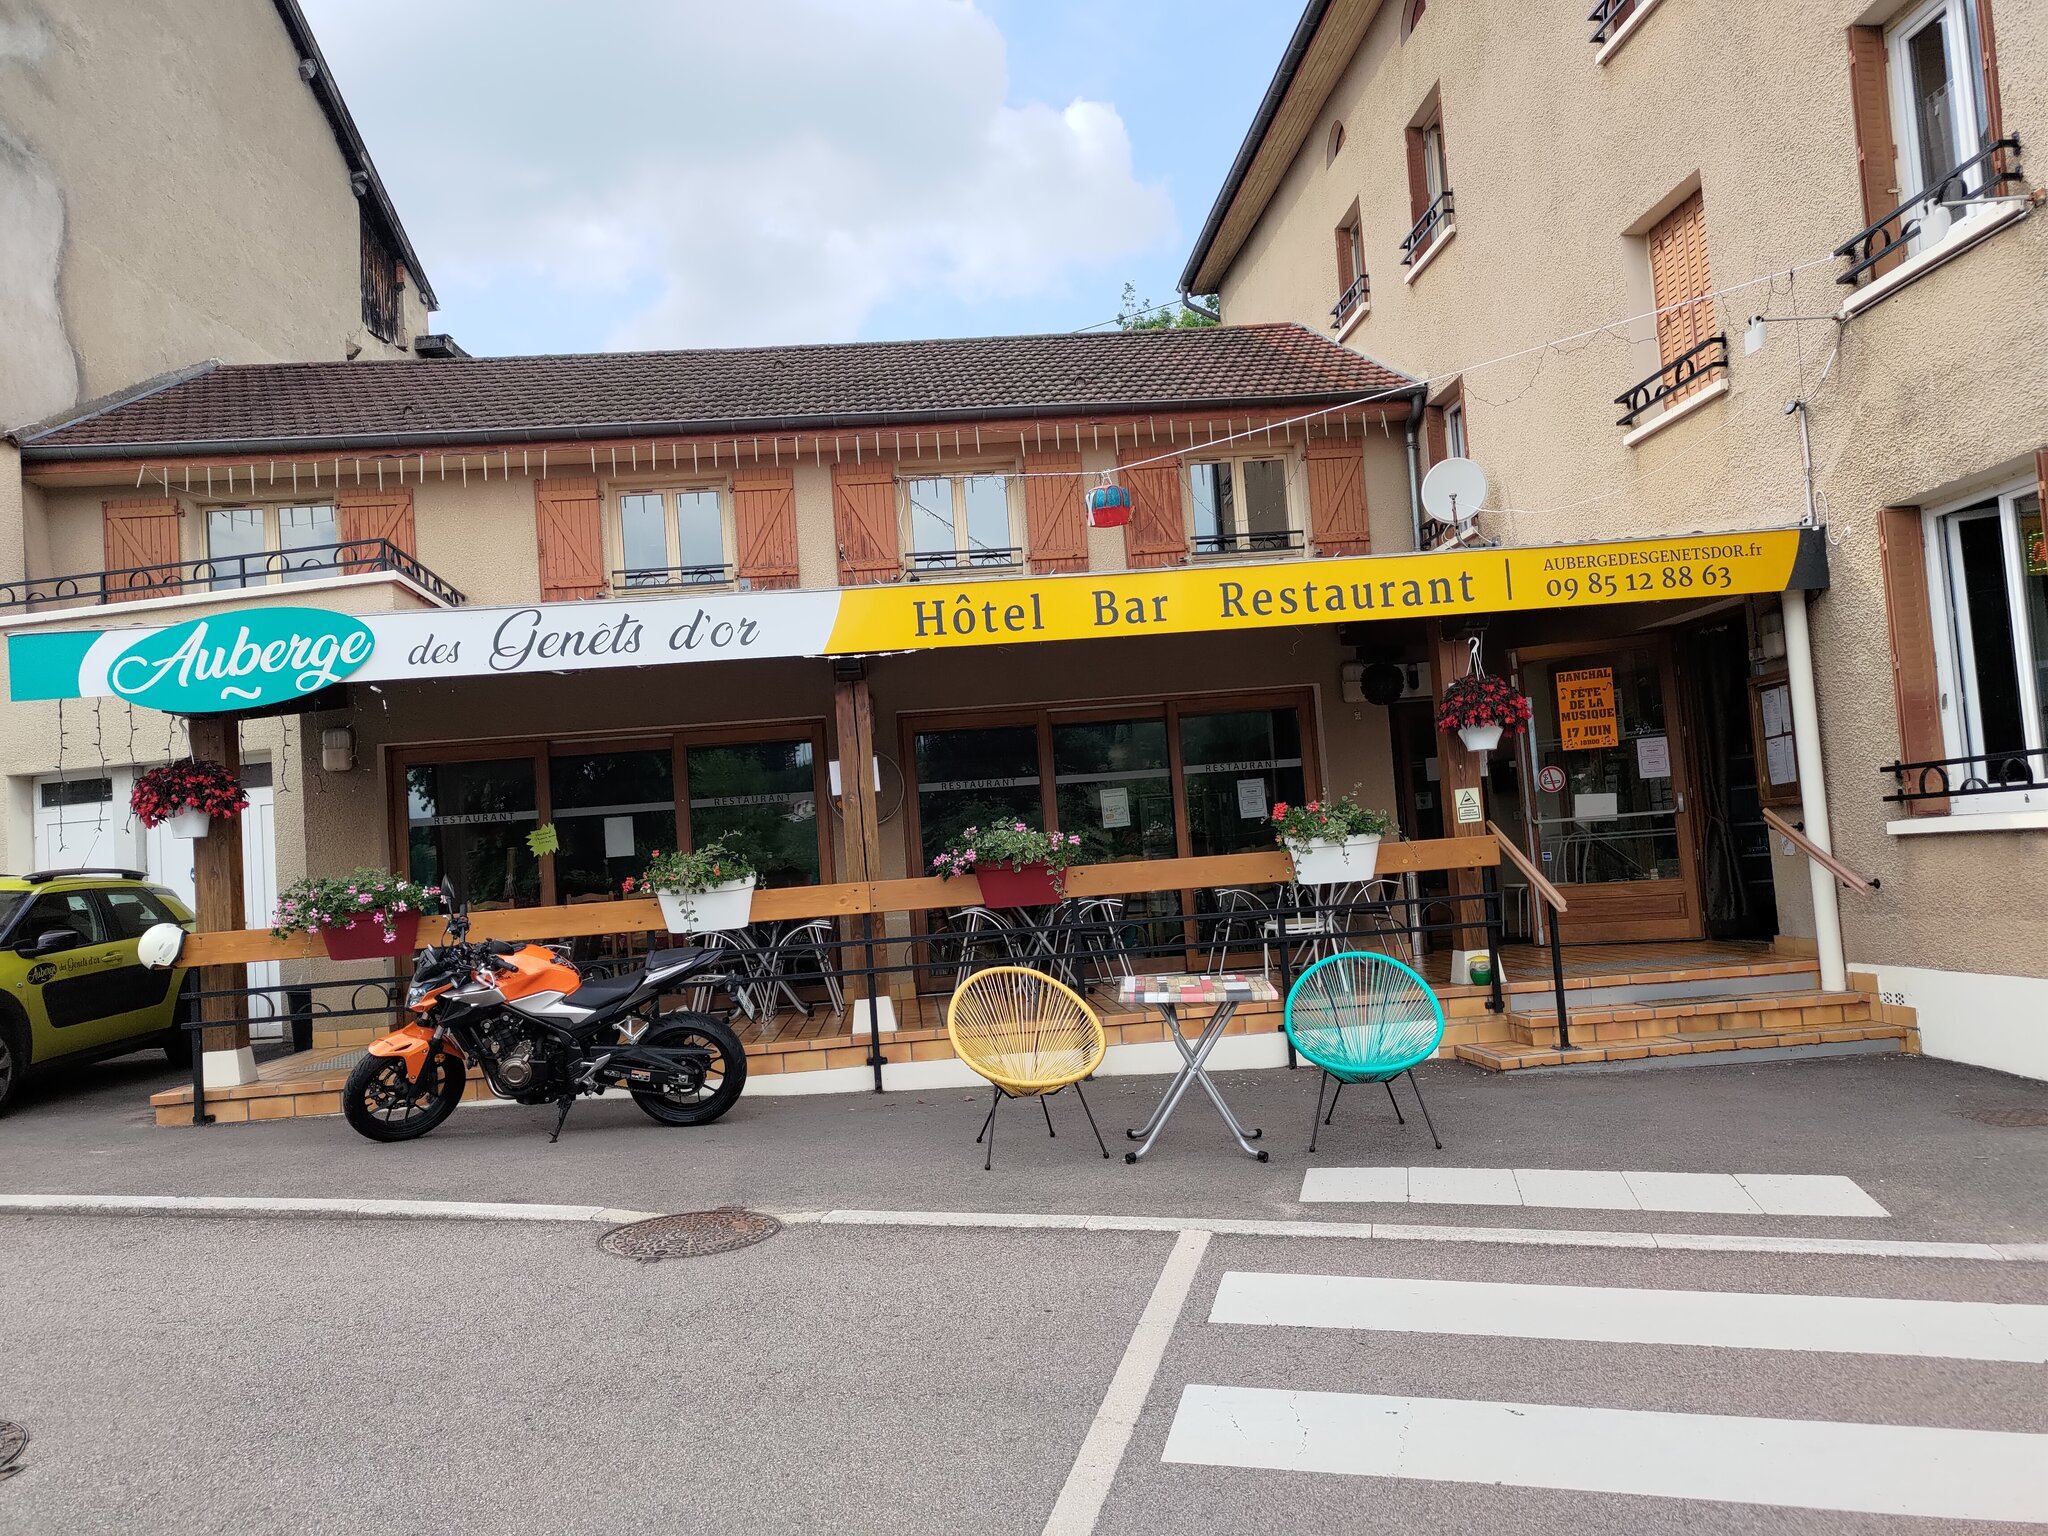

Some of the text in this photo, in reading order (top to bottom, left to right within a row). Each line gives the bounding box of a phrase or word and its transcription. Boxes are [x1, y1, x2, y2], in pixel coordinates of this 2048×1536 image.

[1543, 543, 1763, 571] AUBERGEDESGENETSDOR.fr
[1546, 564, 1731, 600] 09 85 12 88 63
[914, 571, 1475, 637] Hôtel Bar Restaurant
[113, 608, 760, 694] Auberge des Genêts d'or
[1558, 669, 1610, 682] RANCHAL
[1571, 687, 1601, 699] FÊTE
[1569, 698, 1604, 710] DE LA
[1561, 708, 1614, 721] MUSIQUE
[1567, 725, 1611, 738] 17 JUIN
[1205, 760, 1278, 772] RESTAURANT
[940, 778, 1016, 790] RESTAURANT
[714, 794, 792, 806] RESTAURANT
[434, 812, 514, 825] RESTAURANT
